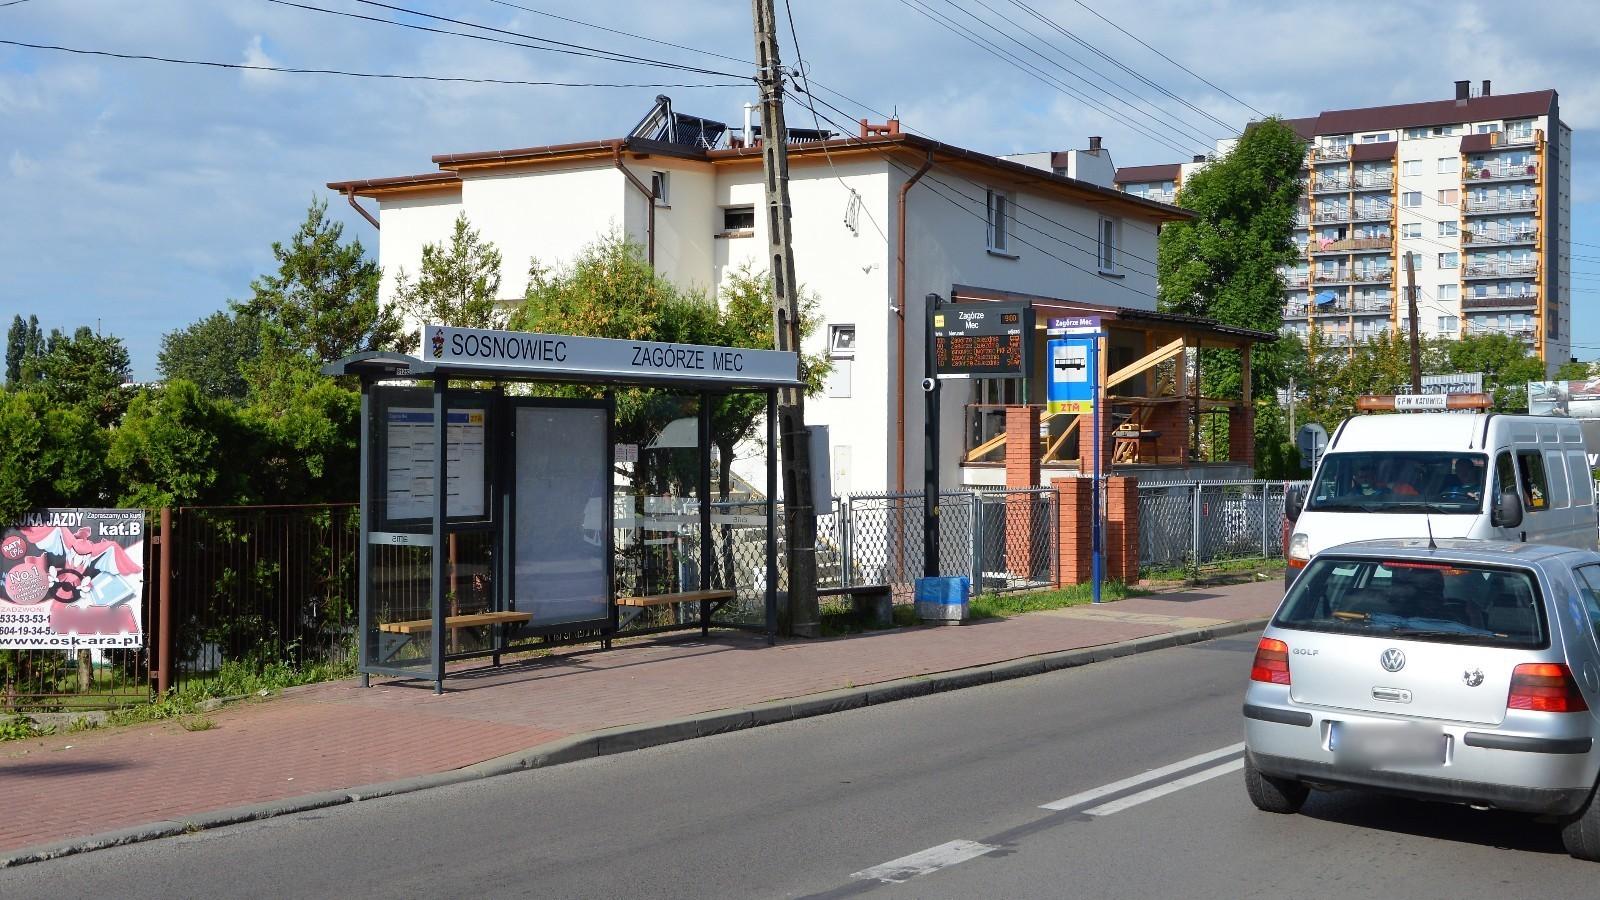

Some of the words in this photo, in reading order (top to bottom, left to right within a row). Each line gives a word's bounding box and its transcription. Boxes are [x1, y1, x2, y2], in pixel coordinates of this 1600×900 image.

[958, 311, 985, 322] Zagórze
[965, 321, 979, 330] Mec
[1055, 319, 1079, 328] Zagórze
[1079, 318, 1093, 326] Mec
[451, 333, 567, 362] SOSNOWIEC
[631, 344, 705, 370] ZAGÓRZE
[712, 351, 743, 371] MEC
[1415, 397, 1444, 405] KATOWICE
[1061, 403, 1080, 411] ZTM
[11, 513, 43, 526] UKA
[46, 512, 84, 526] JAZDY
[87, 512, 121, 520] Zapraszamy
[99, 522, 141, 536] kat.B
[3, 539, 21, 552] RATY
[9, 566, 40, 584] No.1
[0, 615, 51, 623] 533-53-53-1
[0, 636, 139, 646] www.osk-ara.pl
[1292, 648, 1319, 656] GOLF
